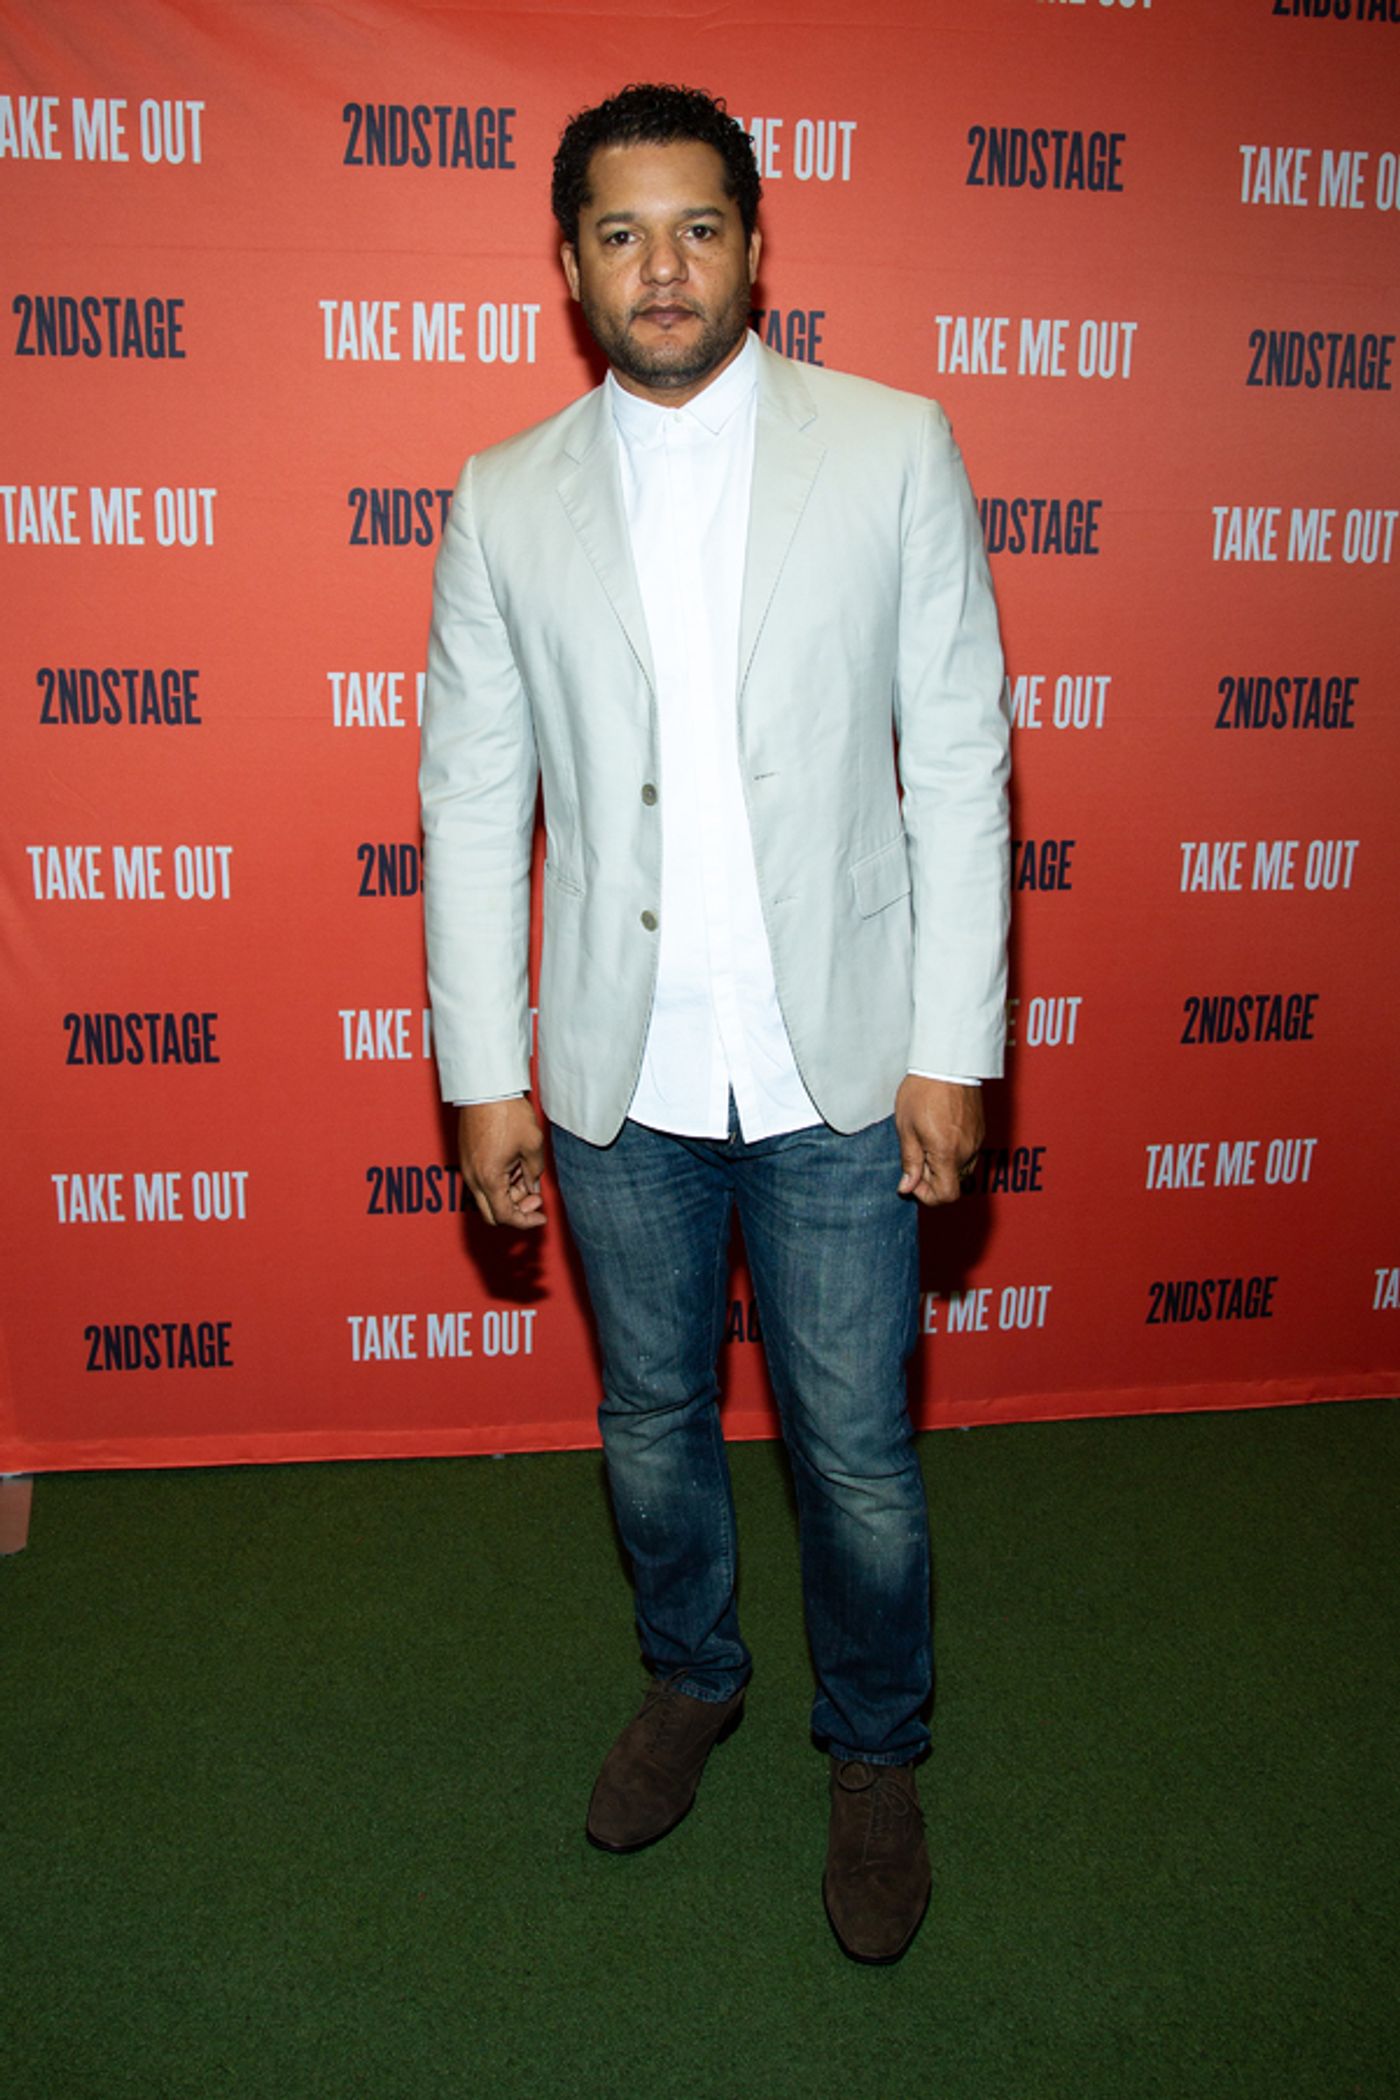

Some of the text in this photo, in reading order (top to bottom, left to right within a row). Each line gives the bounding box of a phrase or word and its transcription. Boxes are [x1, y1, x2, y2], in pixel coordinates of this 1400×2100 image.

[0, 95, 205, 165] AKE ME OUT
[342, 101, 517, 170] 2NDSTAGE
[793, 118, 857, 182] OUT
[966, 125, 1127, 193] 2NDSTAGE
[1239, 144, 1312, 207] TAKE
[1318, 149, 1369, 209] ME
[12, 294, 186, 359] 2NDSTAGE
[319, 300, 541, 364] TAKE ME OUT
[934, 315, 1138, 379] TAKE ME OUT
[1246, 329, 1397, 391] 2NDSTAGE
[0, 485, 217, 547] TAKE ME OUT
[348, 487, 453, 546] 2NDST
[980, 498, 1103, 555] DSTAGE
[1212, 506, 1400, 564] TAKE ME OUT
[36, 667, 202, 726] 2NDSTAGE
[326, 671, 406, 727] TAKE
[1052, 674, 1112, 730] OUT
[1215, 676, 1360, 730] 2NDSTAGE
[26, 844, 233, 900] TAKE ME OUT
[1011, 840, 1076, 891] TAGE
[1180, 839, 1360, 892] TAKE ME OUT
[63, 1012, 221, 1066] 2NDSTAGE
[338, 1008, 413, 1061] TAKE
[1026, 996, 1083, 1047] OUT
[1180, 993, 1320, 1045] 2NDSTAGE
[979, 1146, 1047, 1193] TAGE
[1145, 1138, 1318, 1190] TAKE ME OUT
[51, 1171, 249, 1223] TAKE ME OUT
[946, 1288, 993, 1333] ME
[998, 1285, 1052, 1330] OUT
[1145, 1275, 1279, 1325] 2NDSTAGE
[83, 1321, 234, 1372] 2NDSTAGE
[347, 1309, 537, 1361] TAKE ME OUT
